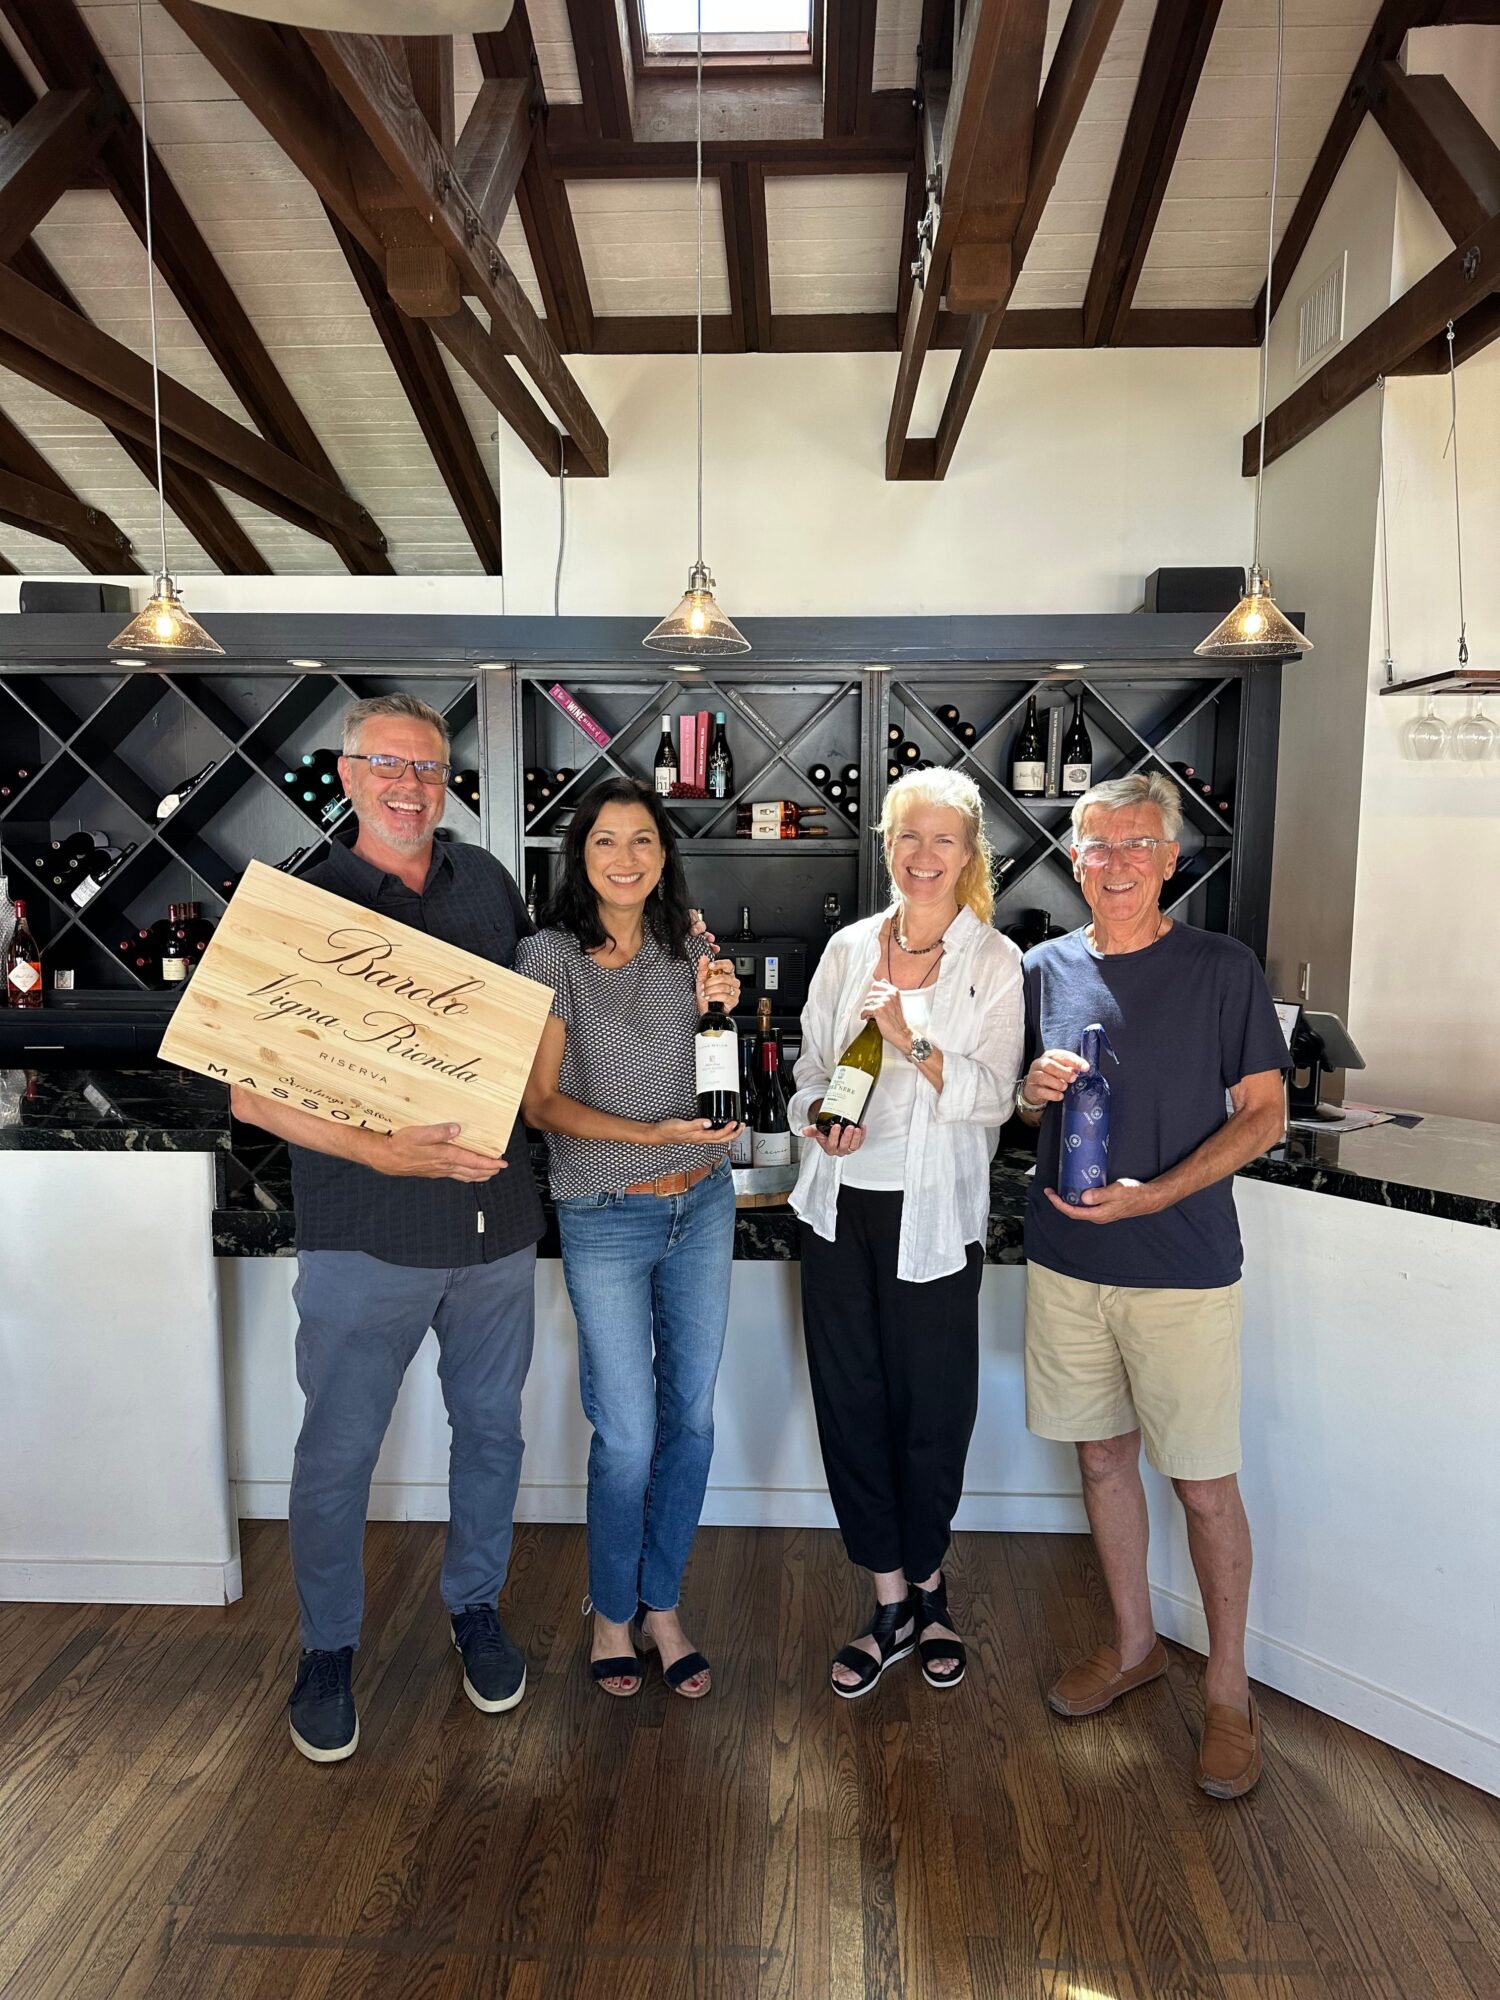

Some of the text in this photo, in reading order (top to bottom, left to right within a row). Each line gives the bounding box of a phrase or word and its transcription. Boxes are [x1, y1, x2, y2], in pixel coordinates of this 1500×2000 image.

[567, 701, 586, 722] WINE
[656, 768, 672, 791] hil
[297, 928, 486, 1016] Barolo
[247, 972, 482, 1084] Vigna Rionda
[319, 1051, 388, 1084] RISERVA
